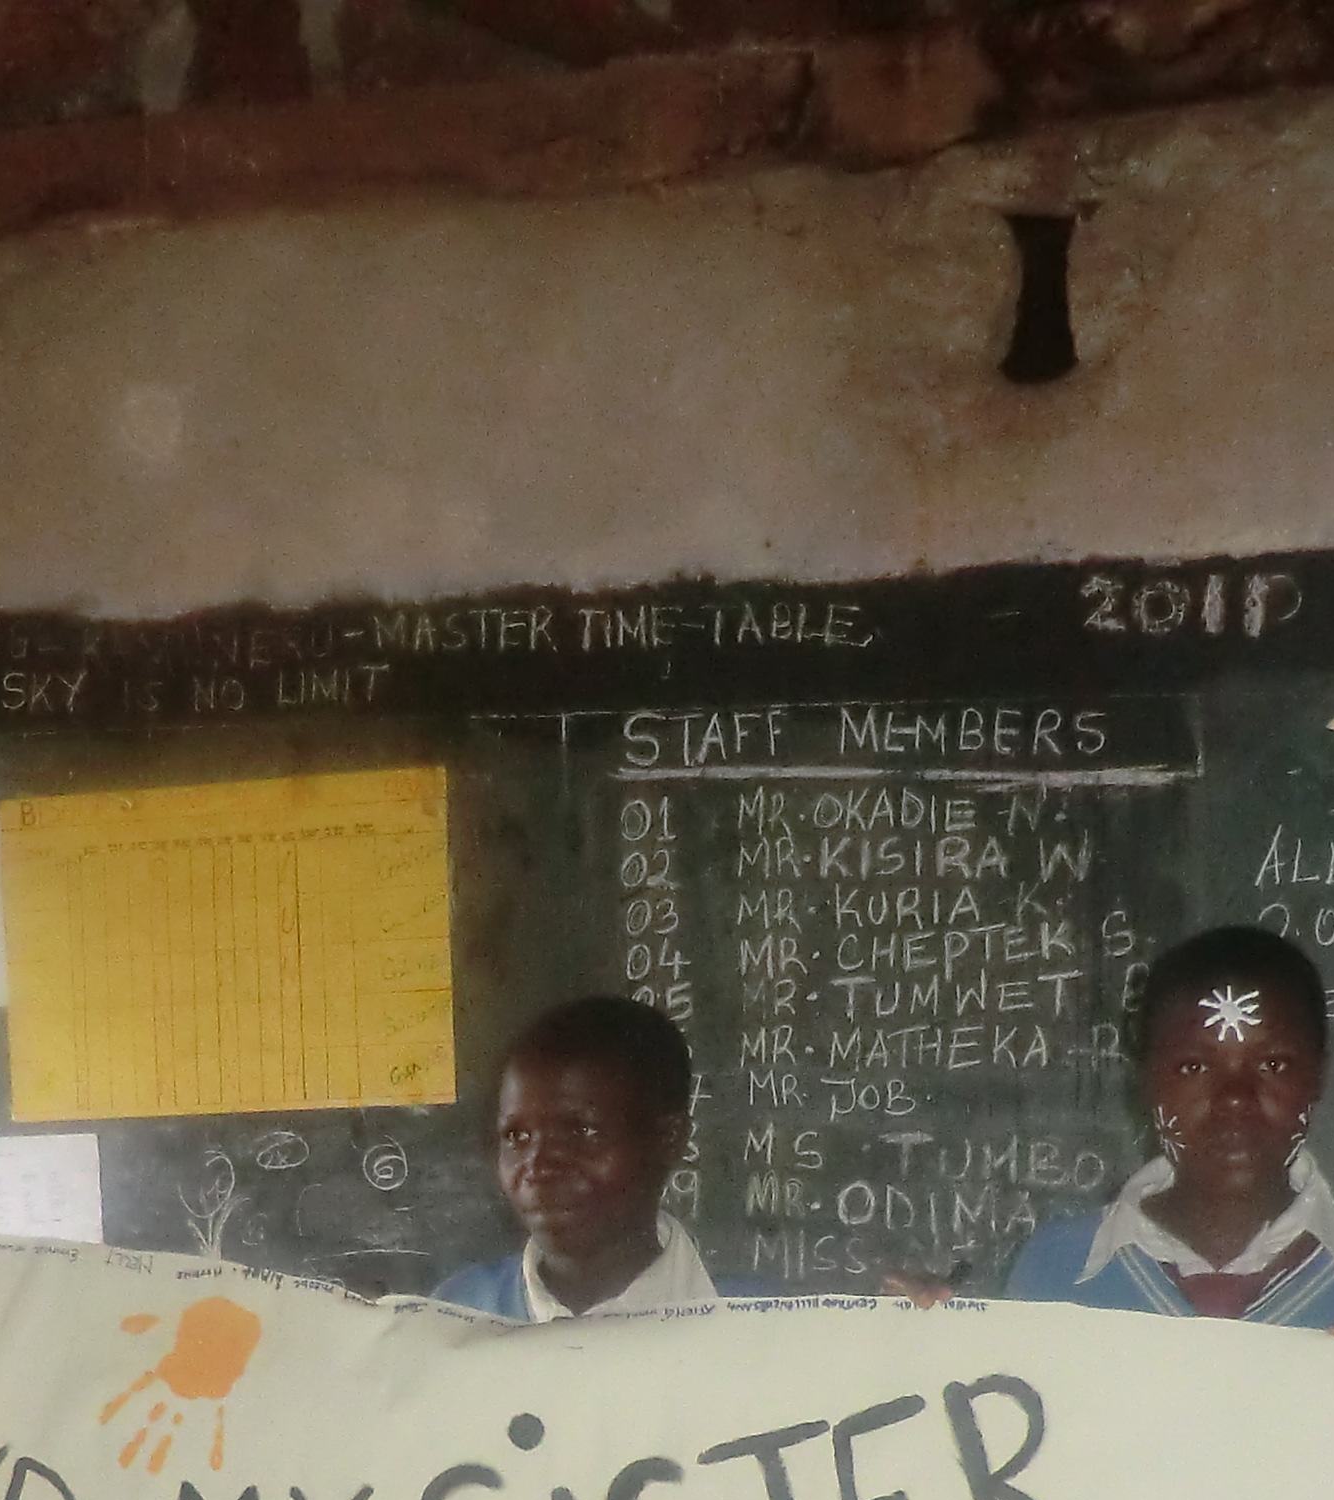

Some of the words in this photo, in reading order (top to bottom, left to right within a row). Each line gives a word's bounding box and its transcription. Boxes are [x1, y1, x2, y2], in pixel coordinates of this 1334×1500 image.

[0, 669, 87, 714] SKY
[192, 677, 247, 712] NO
[275, 664, 389, 707] LIMIT
[623, 709, 788, 768] STAFF
[838, 709, 1109, 756] MEMBERS
[620, 796, 678, 843] 01
[620, 848, 681, 890] 02
[818, 834, 1009, 881] KISIRA
[625, 898, 680, 936] 03
[833, 881, 982, 930] KURIA
[625, 943, 693, 981] 04
[836, 921, 1074, 973] CHEPTEK
[828, 970, 1085, 1021] TUMWET
[828, 1024, 1050, 1071] MATHEKA
